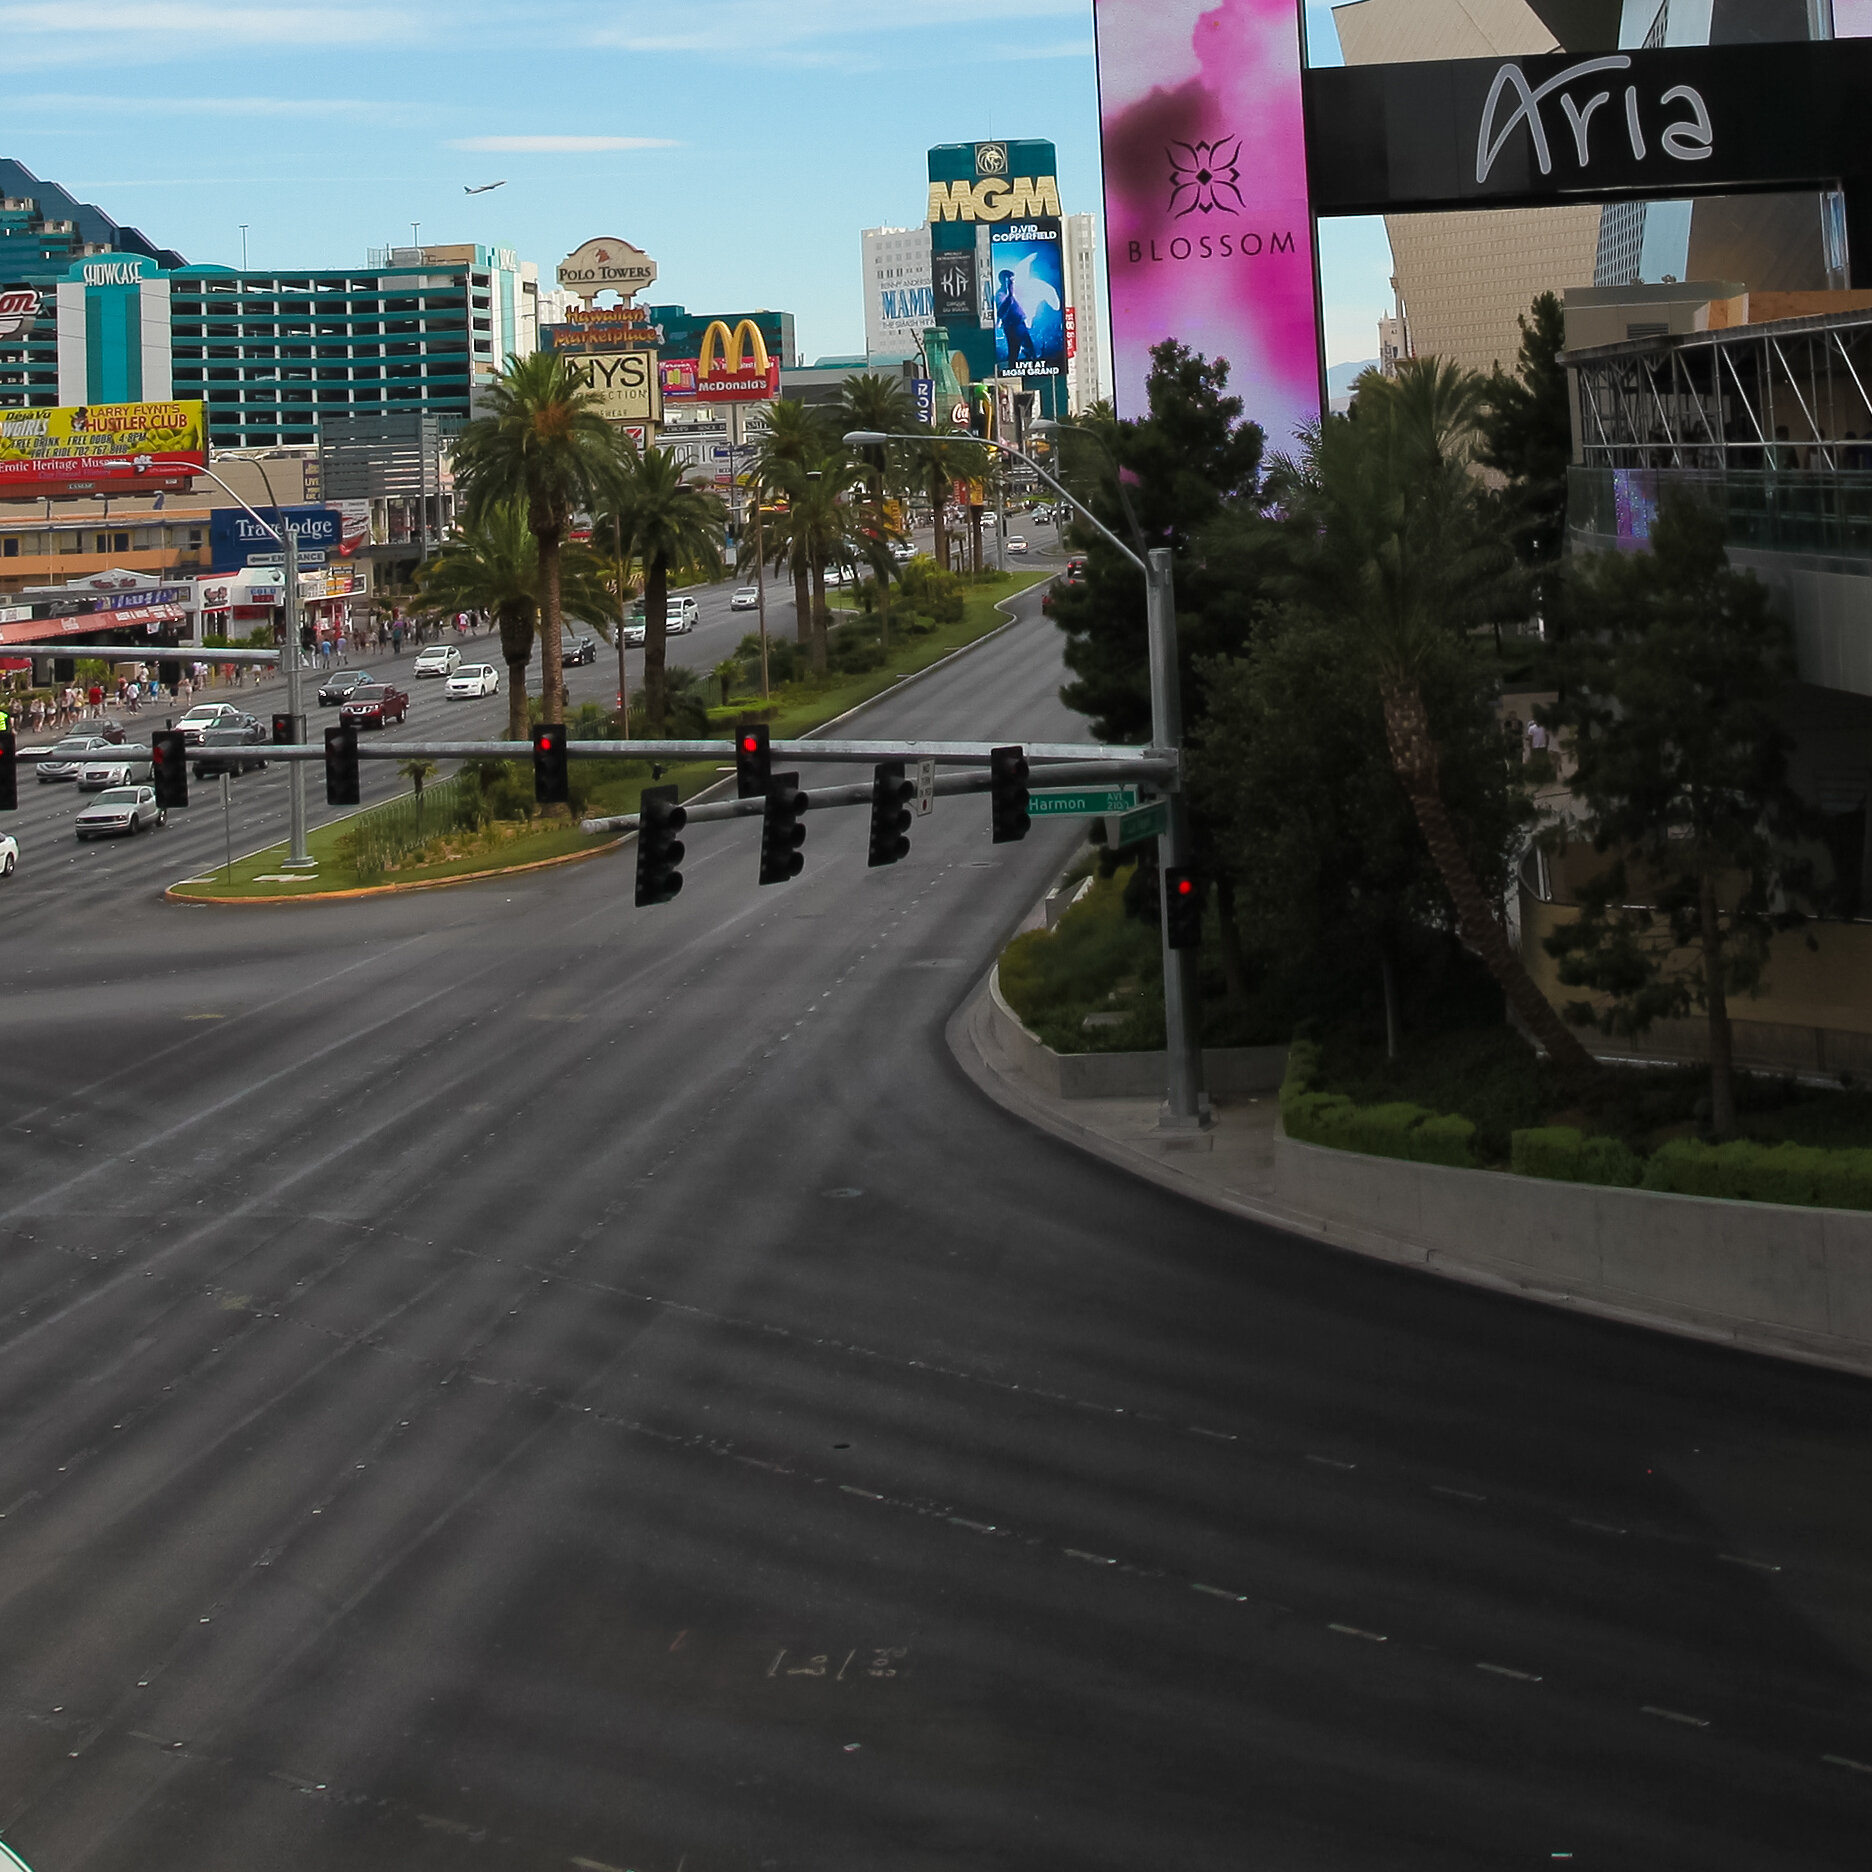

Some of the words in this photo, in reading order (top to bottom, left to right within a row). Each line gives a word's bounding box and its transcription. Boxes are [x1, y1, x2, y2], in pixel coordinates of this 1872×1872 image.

[1475, 54, 1714, 184] Aria
[929, 176, 1061, 222] MGM
[1010, 225, 1038, 233] DAVID
[992, 231, 1057, 242] COPPERFIELD
[1128, 230, 1296, 264] BLOSSOM
[83, 262, 142, 286] SHOWCASE
[559, 268, 595, 281] POLO
[599, 266, 651, 279] TOWERS
[565, 305, 646, 323] Hawaiian
[553, 327, 657, 347] Marketplace
[1003, 368, 1026, 376] MGM
[1027, 367, 1059, 376] GRAND
[698, 380, 767, 392] McDonald's
[90, 407, 128, 417] LARRY
[133, 404, 180, 415] FLYNT'S
[87, 415, 147, 432] HUSTLER
[150, 413, 188, 429] CLUB
[33, 437, 59, 448] DRINK
[67, 435, 87, 445] FREE
[33, 459, 78, 472] Heritage
[271, 552, 324, 563] ENANCE
[1029, 797, 1085, 811] Harmon
